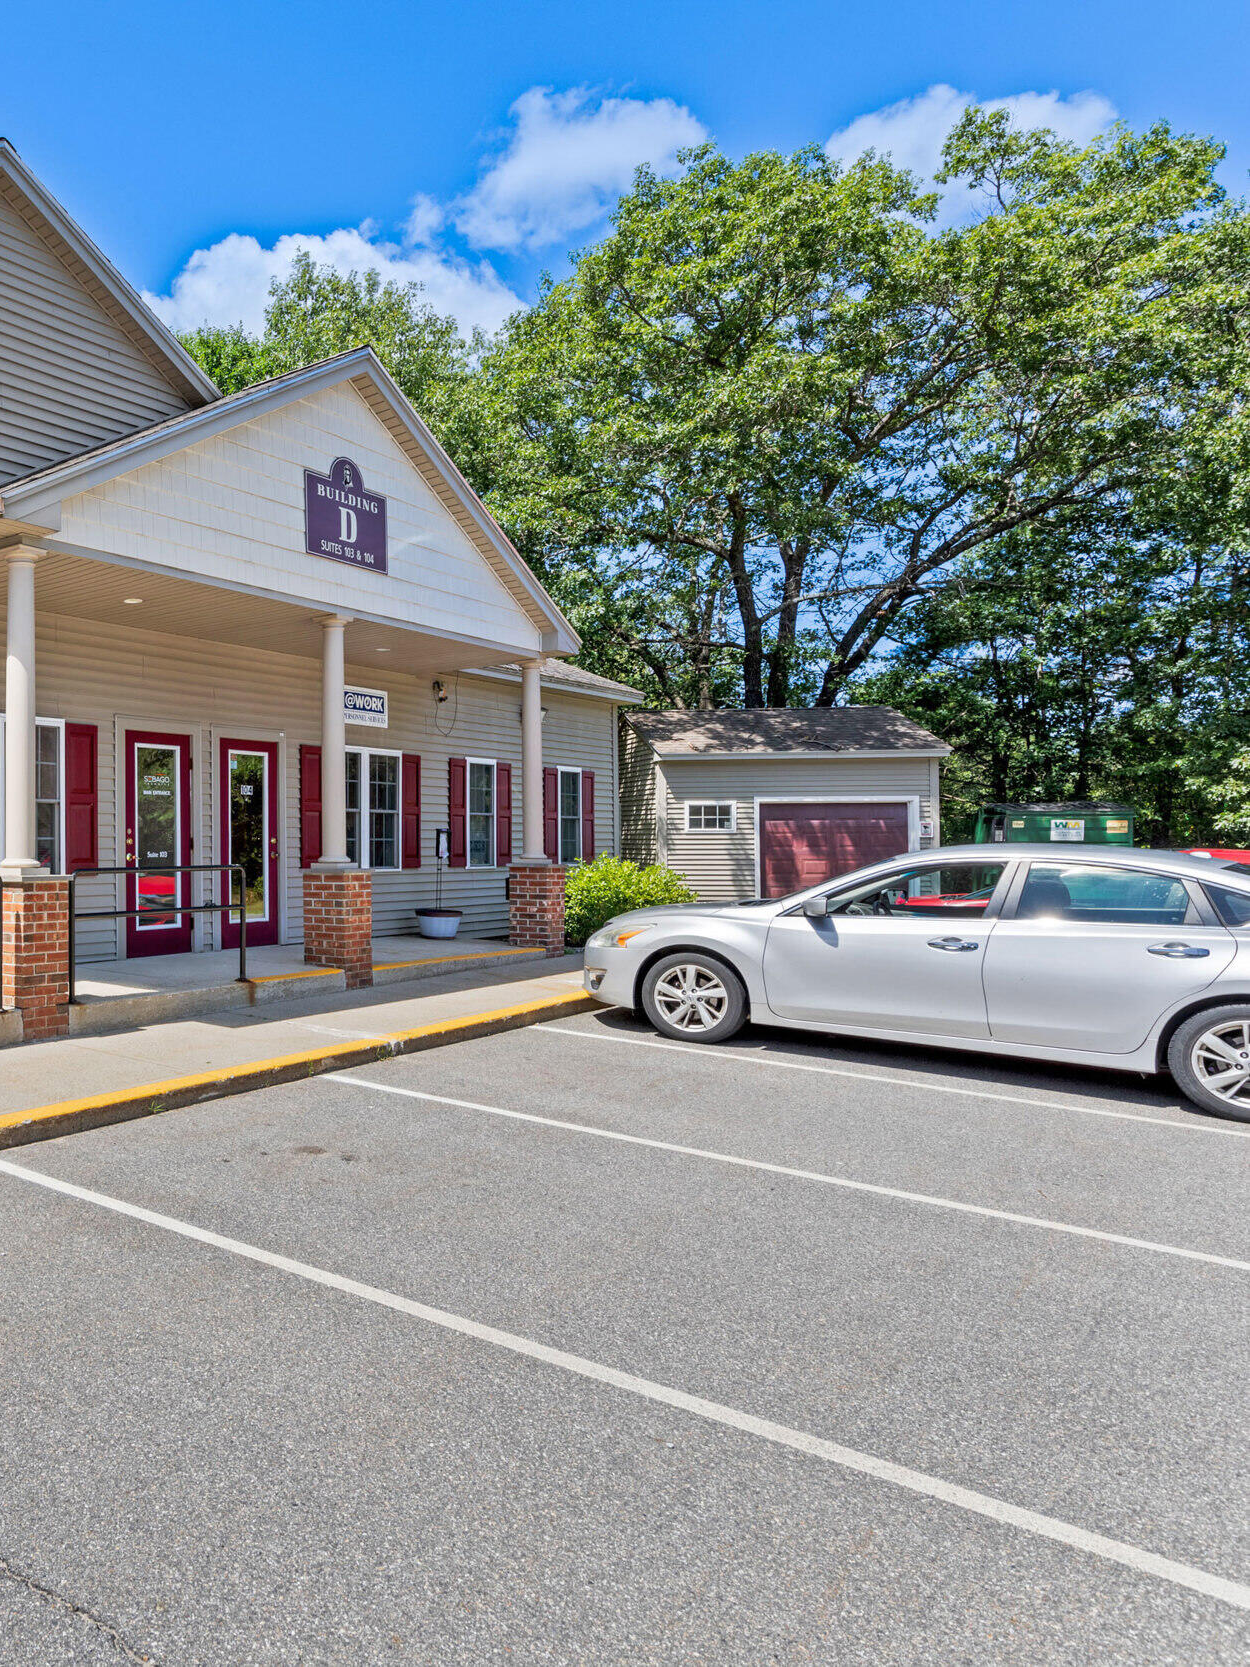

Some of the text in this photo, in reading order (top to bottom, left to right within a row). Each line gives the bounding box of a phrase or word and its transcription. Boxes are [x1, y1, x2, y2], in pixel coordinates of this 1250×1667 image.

[317, 483, 379, 514] BUILDING
[339, 506, 357, 543] D
[321, 540, 375, 565] SUITES 103 & 104
[345, 693, 384, 712] @WORK
[242, 786, 253, 794] 104
